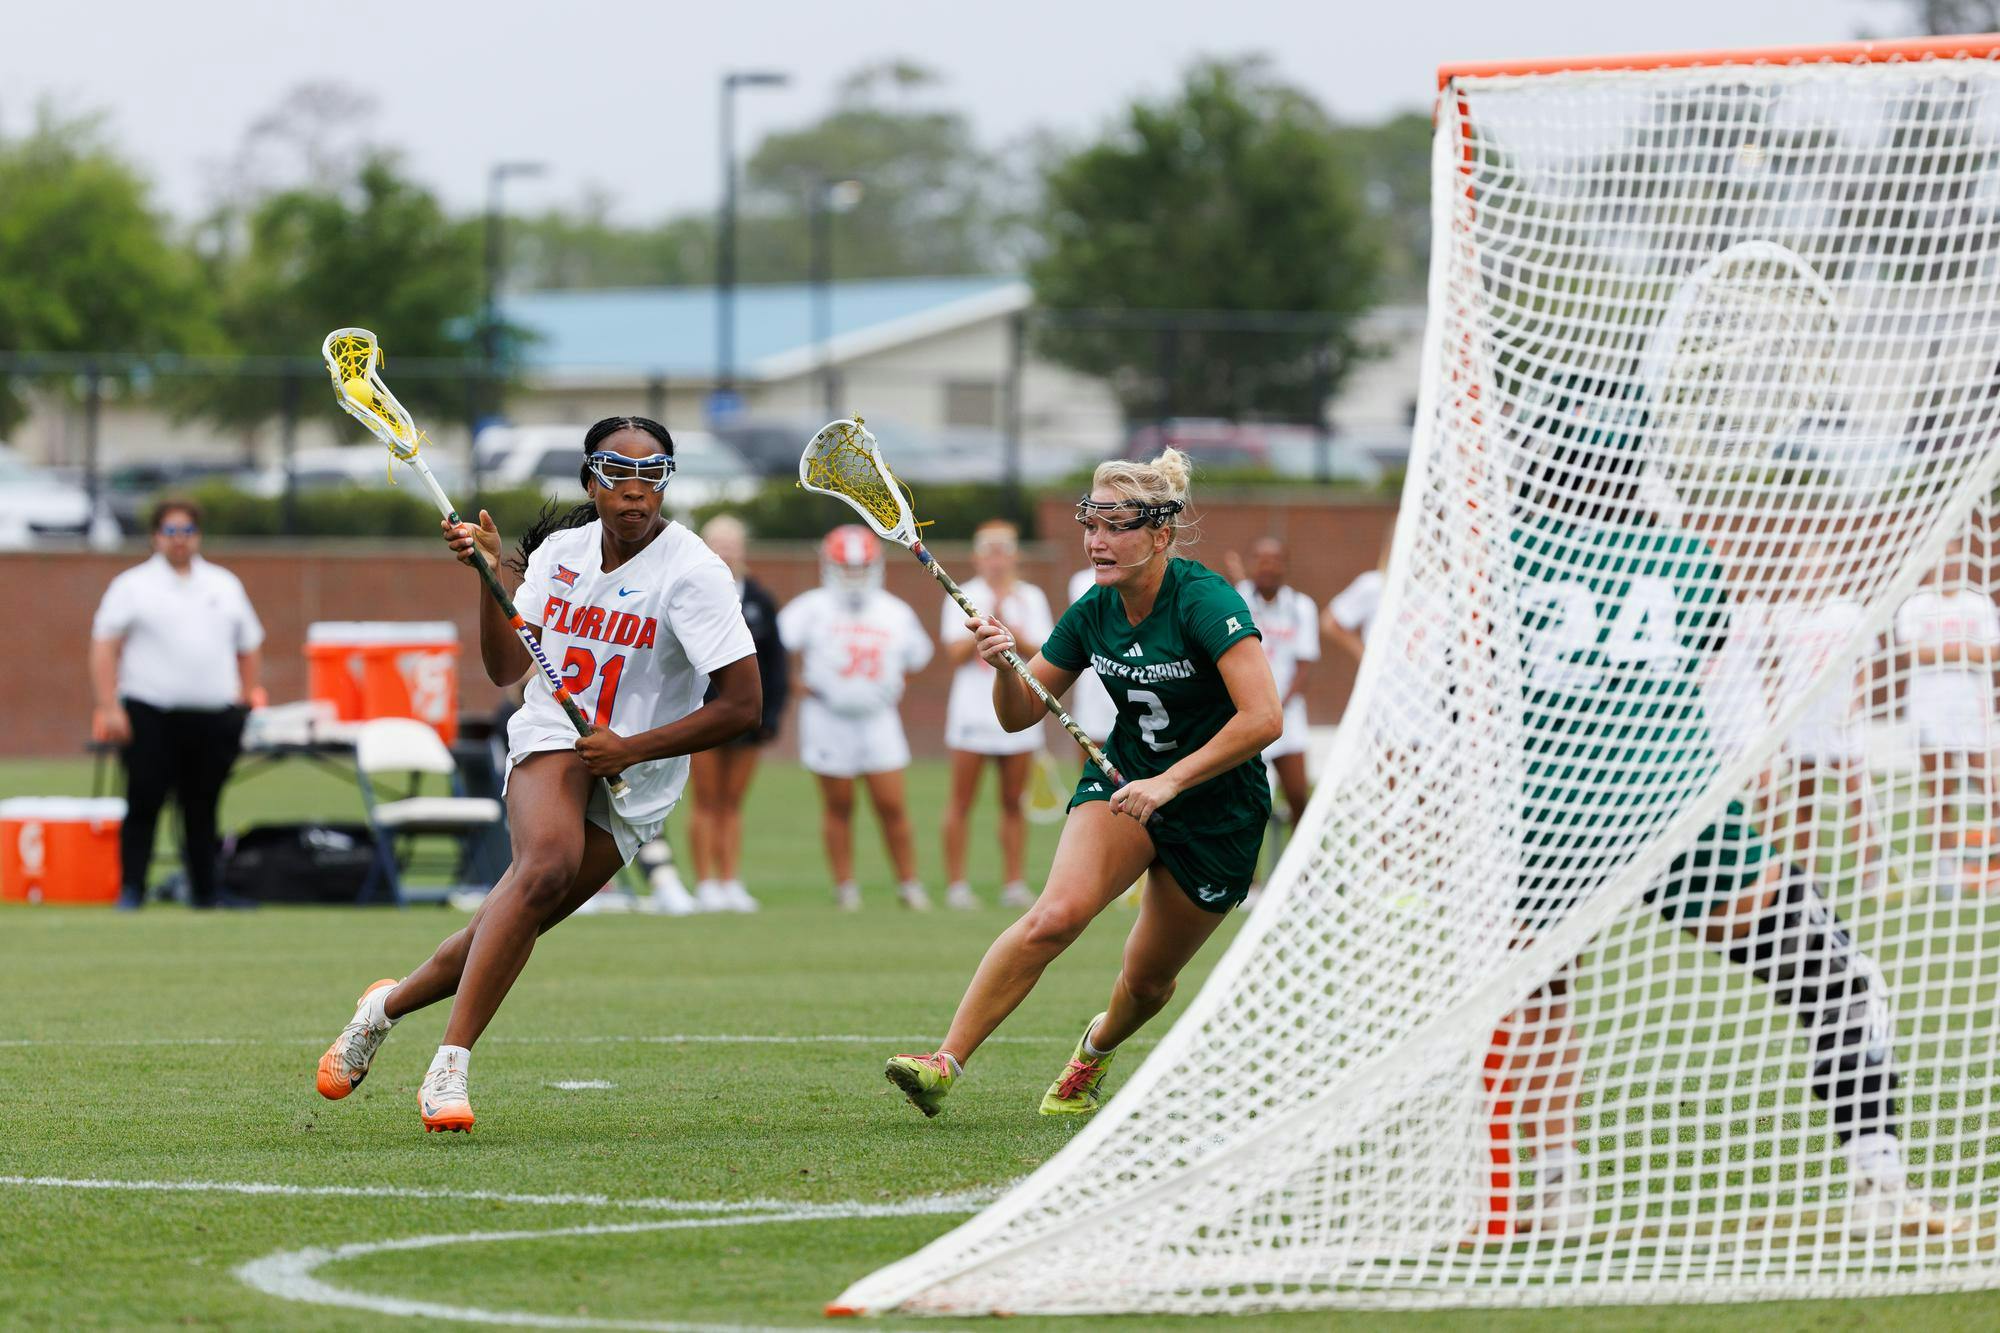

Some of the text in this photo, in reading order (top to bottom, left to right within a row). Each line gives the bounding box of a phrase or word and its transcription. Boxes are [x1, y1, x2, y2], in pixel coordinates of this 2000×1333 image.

[543, 594, 658, 649] FLORIDA
[561, 645, 627, 726] 21
[1130, 658, 1197, 684] FLORIDA
[1127, 689, 1178, 752] 2
